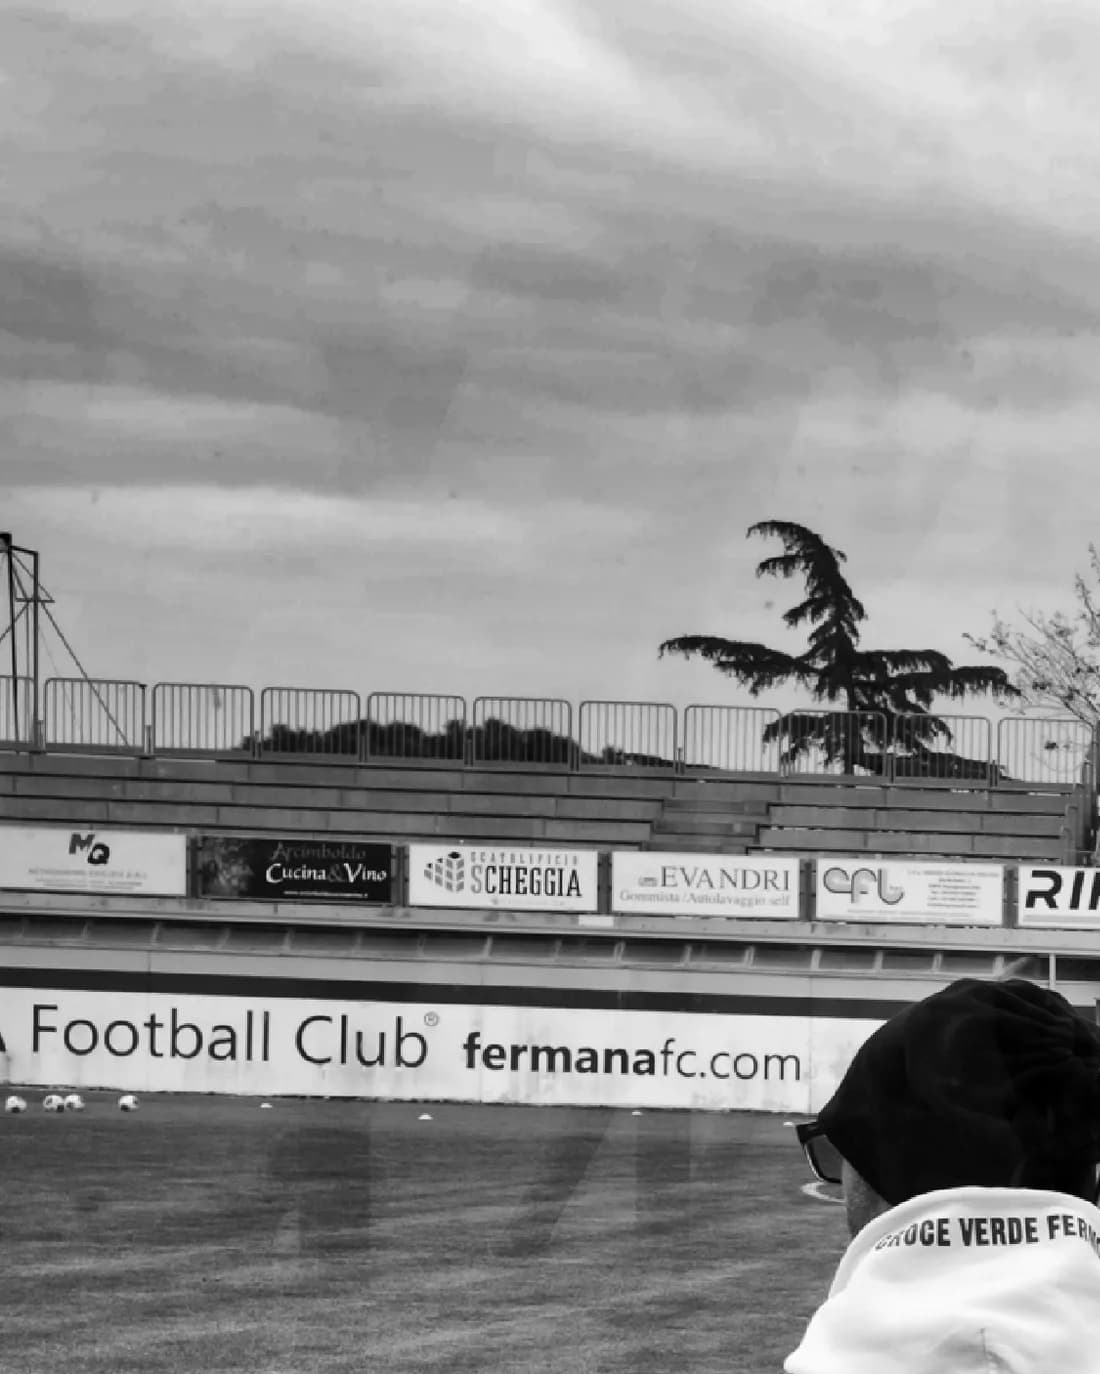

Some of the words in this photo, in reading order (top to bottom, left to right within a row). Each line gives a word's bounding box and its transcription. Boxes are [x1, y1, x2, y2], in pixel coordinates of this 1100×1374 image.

[266, 862, 327, 883] Cucina
[344, 862, 387, 883] Vino
[471, 865, 582, 897] SCHEGGIA
[661, 866, 790, 890] EVANDRI
[33, 1004, 270, 1062] Football
[463, 1031, 801, 1081] fermanafc.com
[958, 1215, 1040, 1247] VERDE
